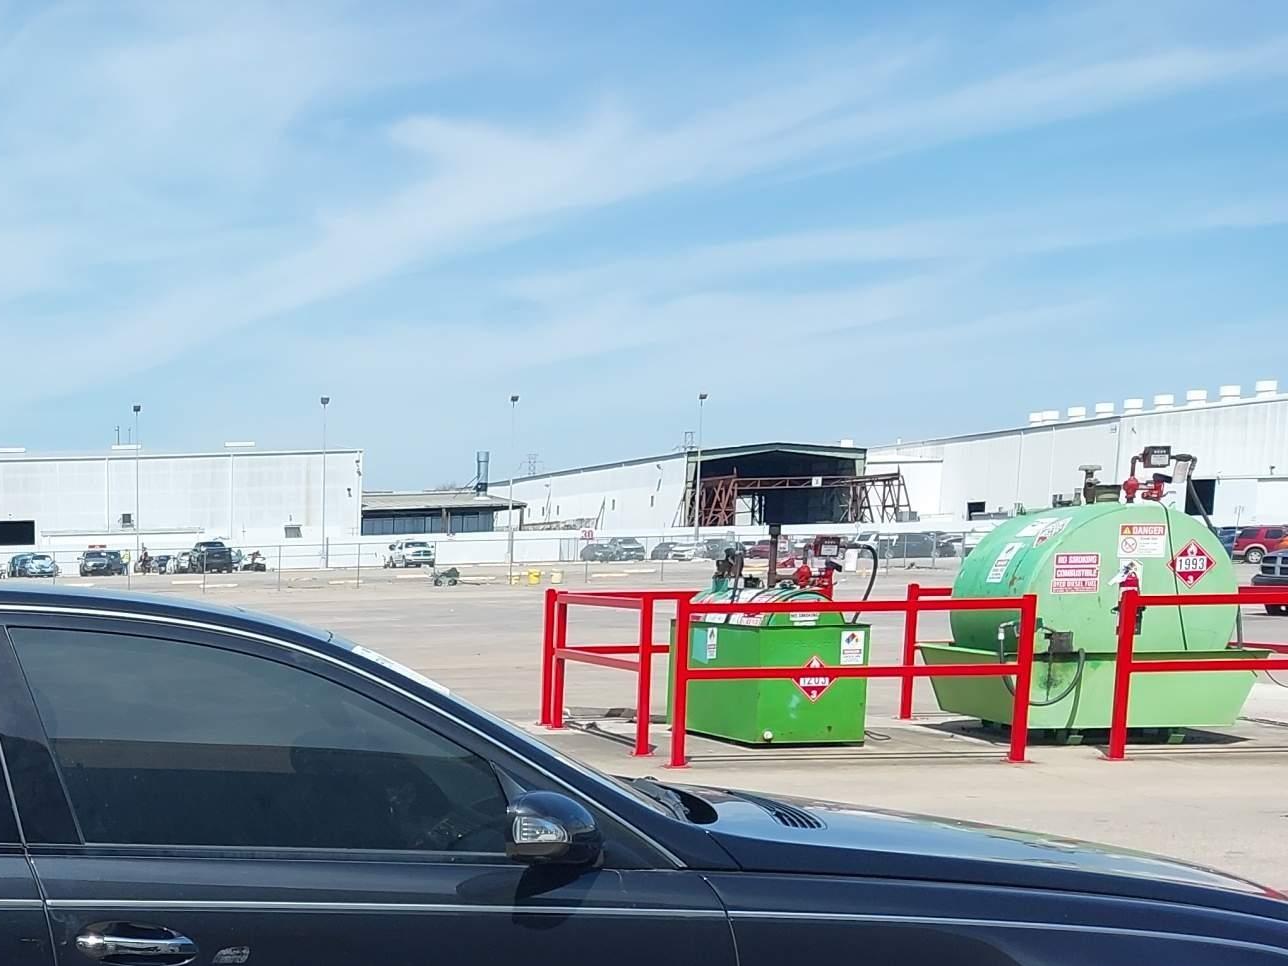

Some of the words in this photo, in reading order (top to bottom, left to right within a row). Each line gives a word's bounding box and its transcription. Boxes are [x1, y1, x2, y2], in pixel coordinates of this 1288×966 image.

[1133, 526, 1164, 534] DANGER
[1068, 555, 1097, 563] SMOKING
[1179, 558, 1205, 570] 1993
[1056, 569, 1097, 577] COMBUSTIBLE
[1187, 575, 1194, 584] 3
[810, 690, 818, 698] 3
